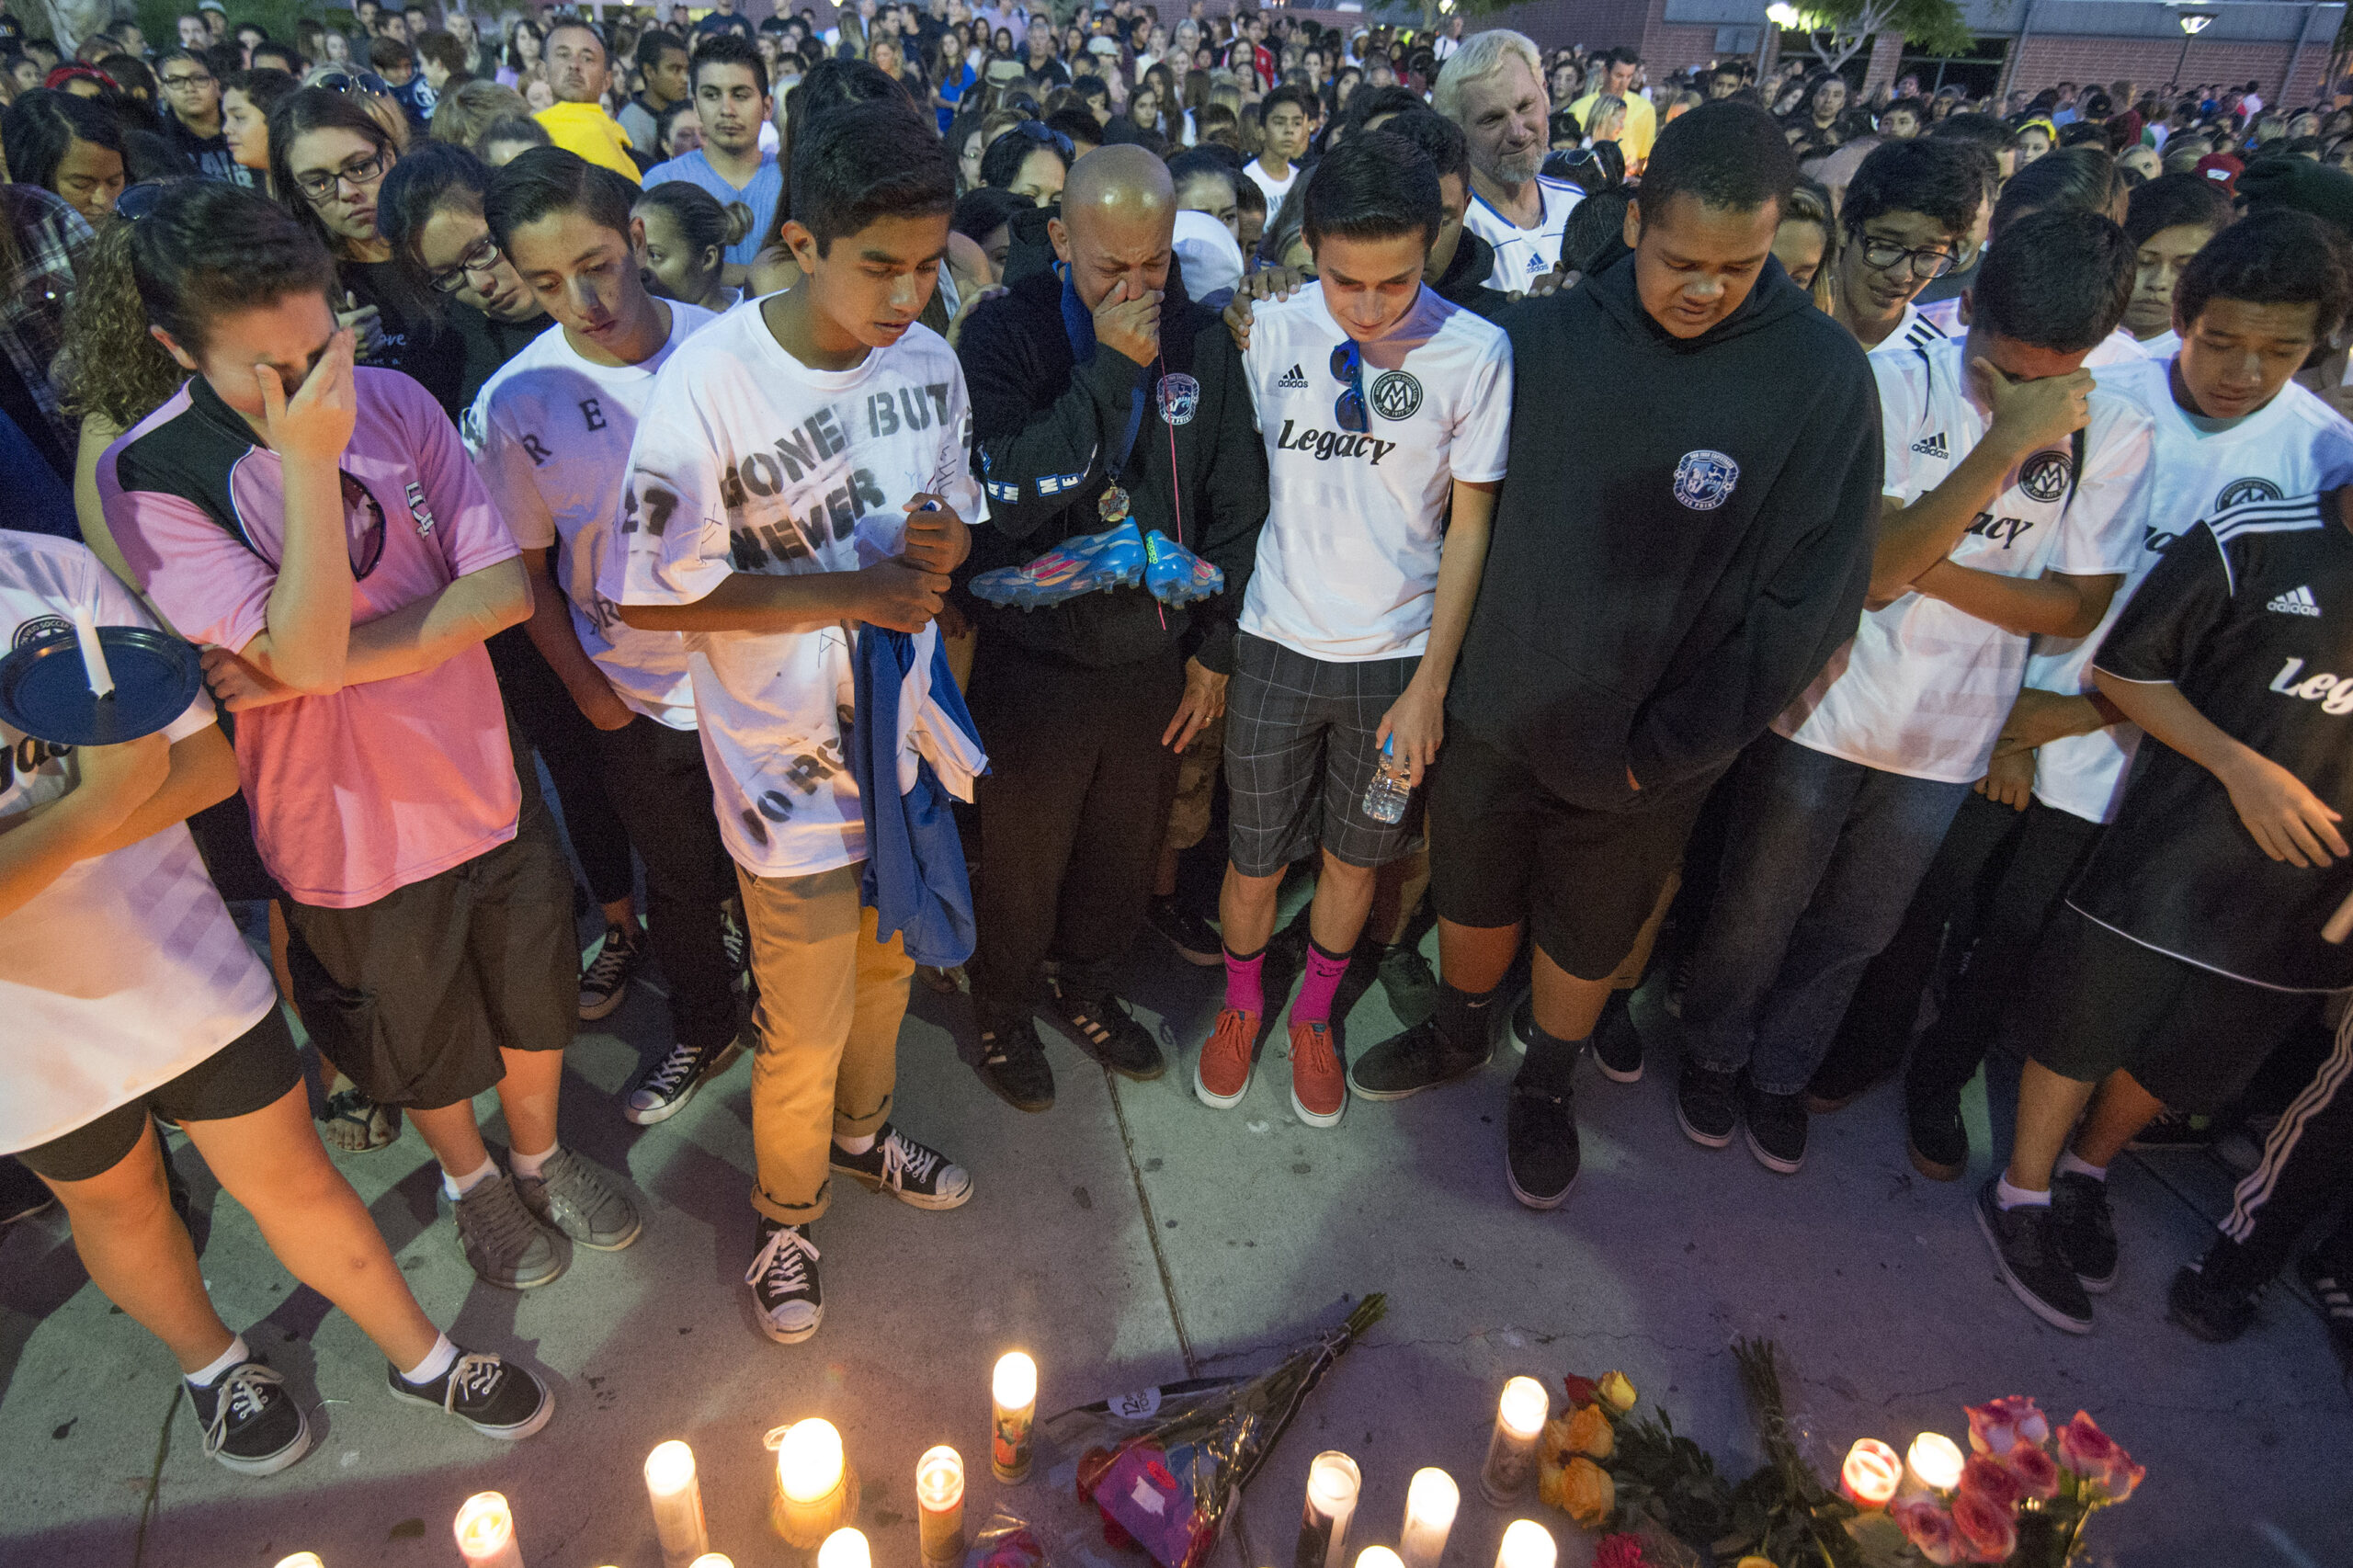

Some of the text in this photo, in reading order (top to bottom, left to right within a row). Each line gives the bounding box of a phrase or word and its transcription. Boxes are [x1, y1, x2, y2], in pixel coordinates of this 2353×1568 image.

[1526, 264, 1549, 274] adidas
[1279, 379, 1309, 388] adidas
[867, 382, 949, 437] BUT
[1278, 419, 1396, 465] Legacy
[1911, 443, 1949, 460] adidas
[730, 468, 886, 571] NEVER
[1963, 511, 2034, 550] acy
[2267, 600, 2322, 617] adidas
